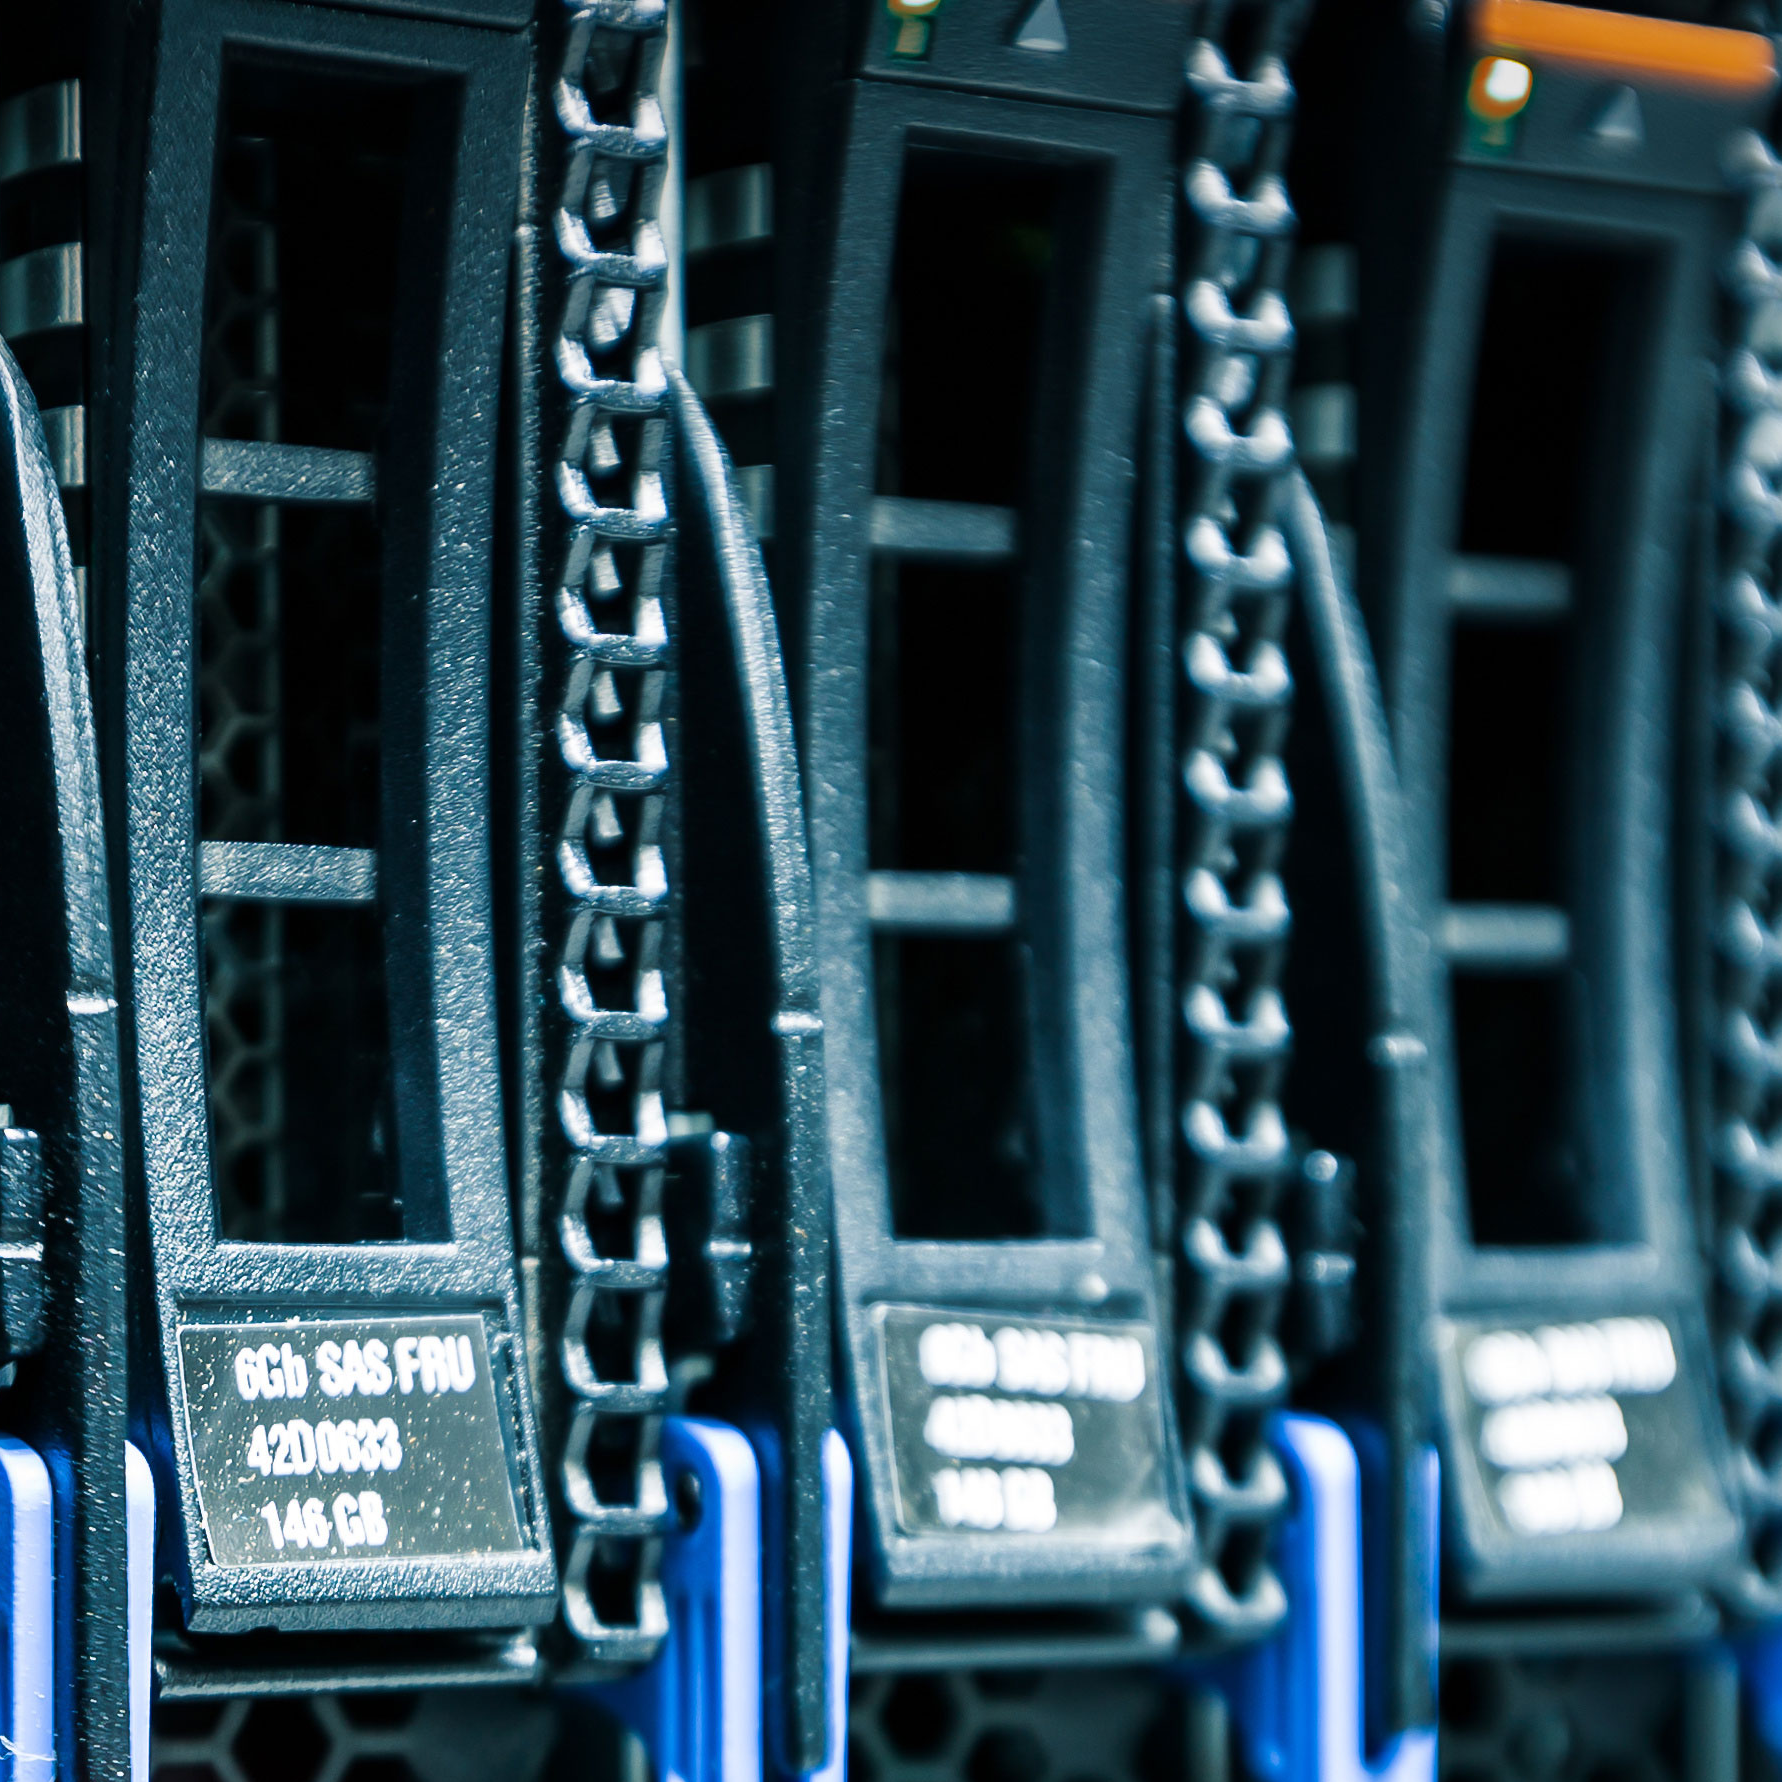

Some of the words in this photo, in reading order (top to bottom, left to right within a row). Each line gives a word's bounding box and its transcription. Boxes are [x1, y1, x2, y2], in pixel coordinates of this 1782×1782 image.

[234, 1342, 309, 1401] 6Gb
[318, 1339, 393, 1397] SAS
[393, 1335, 476, 1395] FRU
[247, 1417, 403, 1476] 42D0633
[261, 1497, 333, 1550] 146
[333, 1491, 389, 1547] GB
